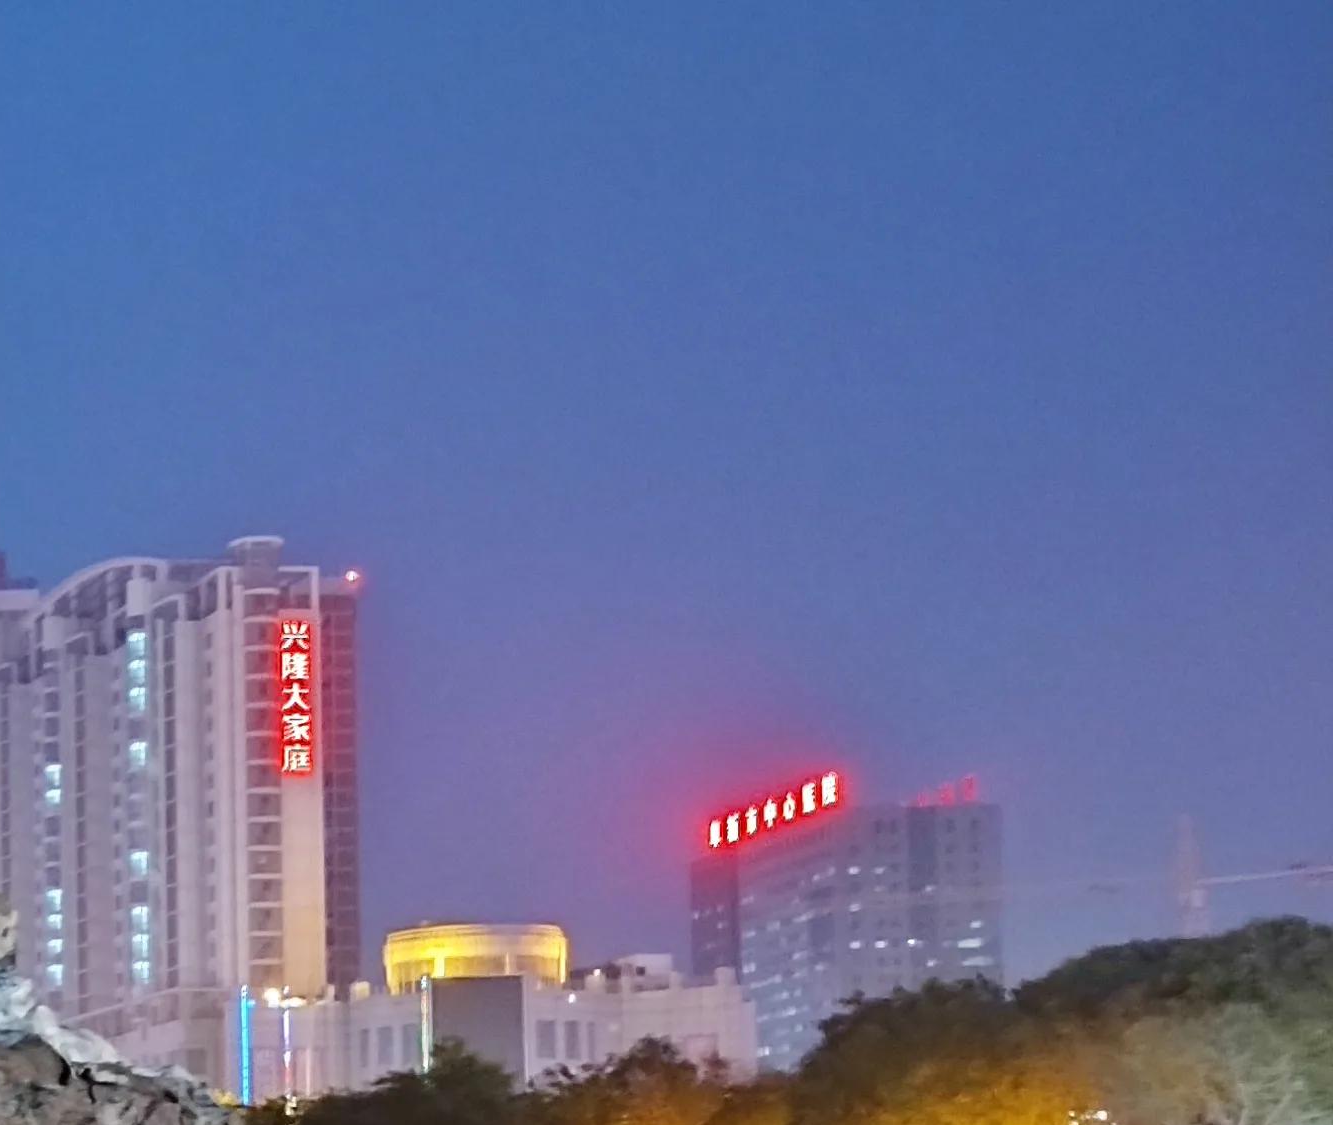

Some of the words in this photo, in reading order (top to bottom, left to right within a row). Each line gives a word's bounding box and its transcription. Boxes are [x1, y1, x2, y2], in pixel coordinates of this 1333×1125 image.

[281, 620, 311, 773] 兴隆大家庭
